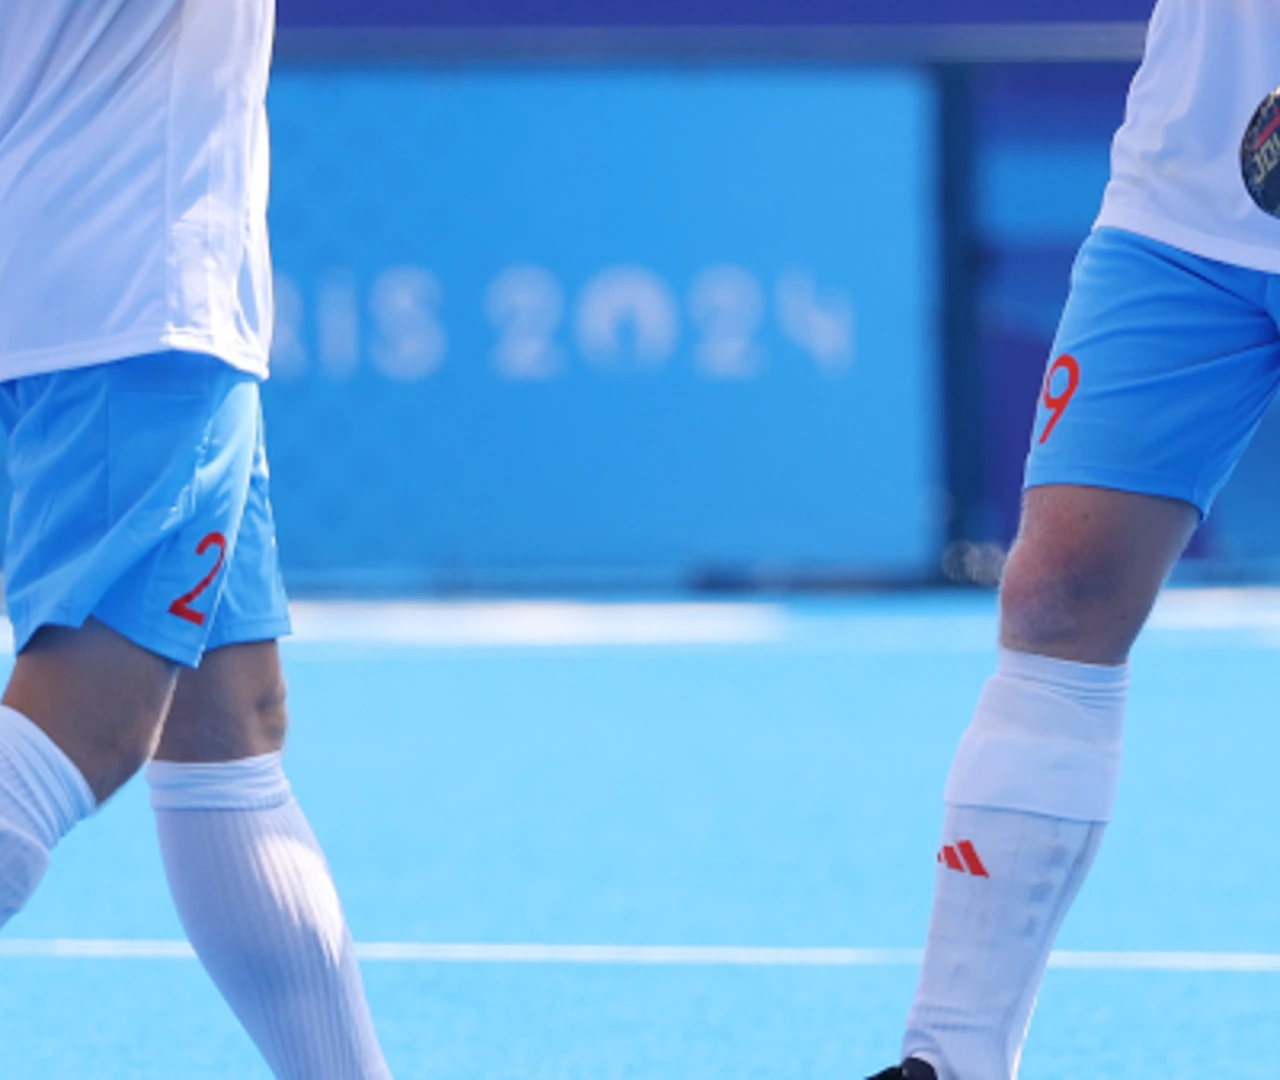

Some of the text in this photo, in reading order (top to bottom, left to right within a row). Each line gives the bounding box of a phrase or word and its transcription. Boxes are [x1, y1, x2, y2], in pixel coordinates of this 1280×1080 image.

[272, 262, 858, 381] RIS 2024
[1038, 352, 1081, 445] 9
[168, 530, 228, 627] 2
